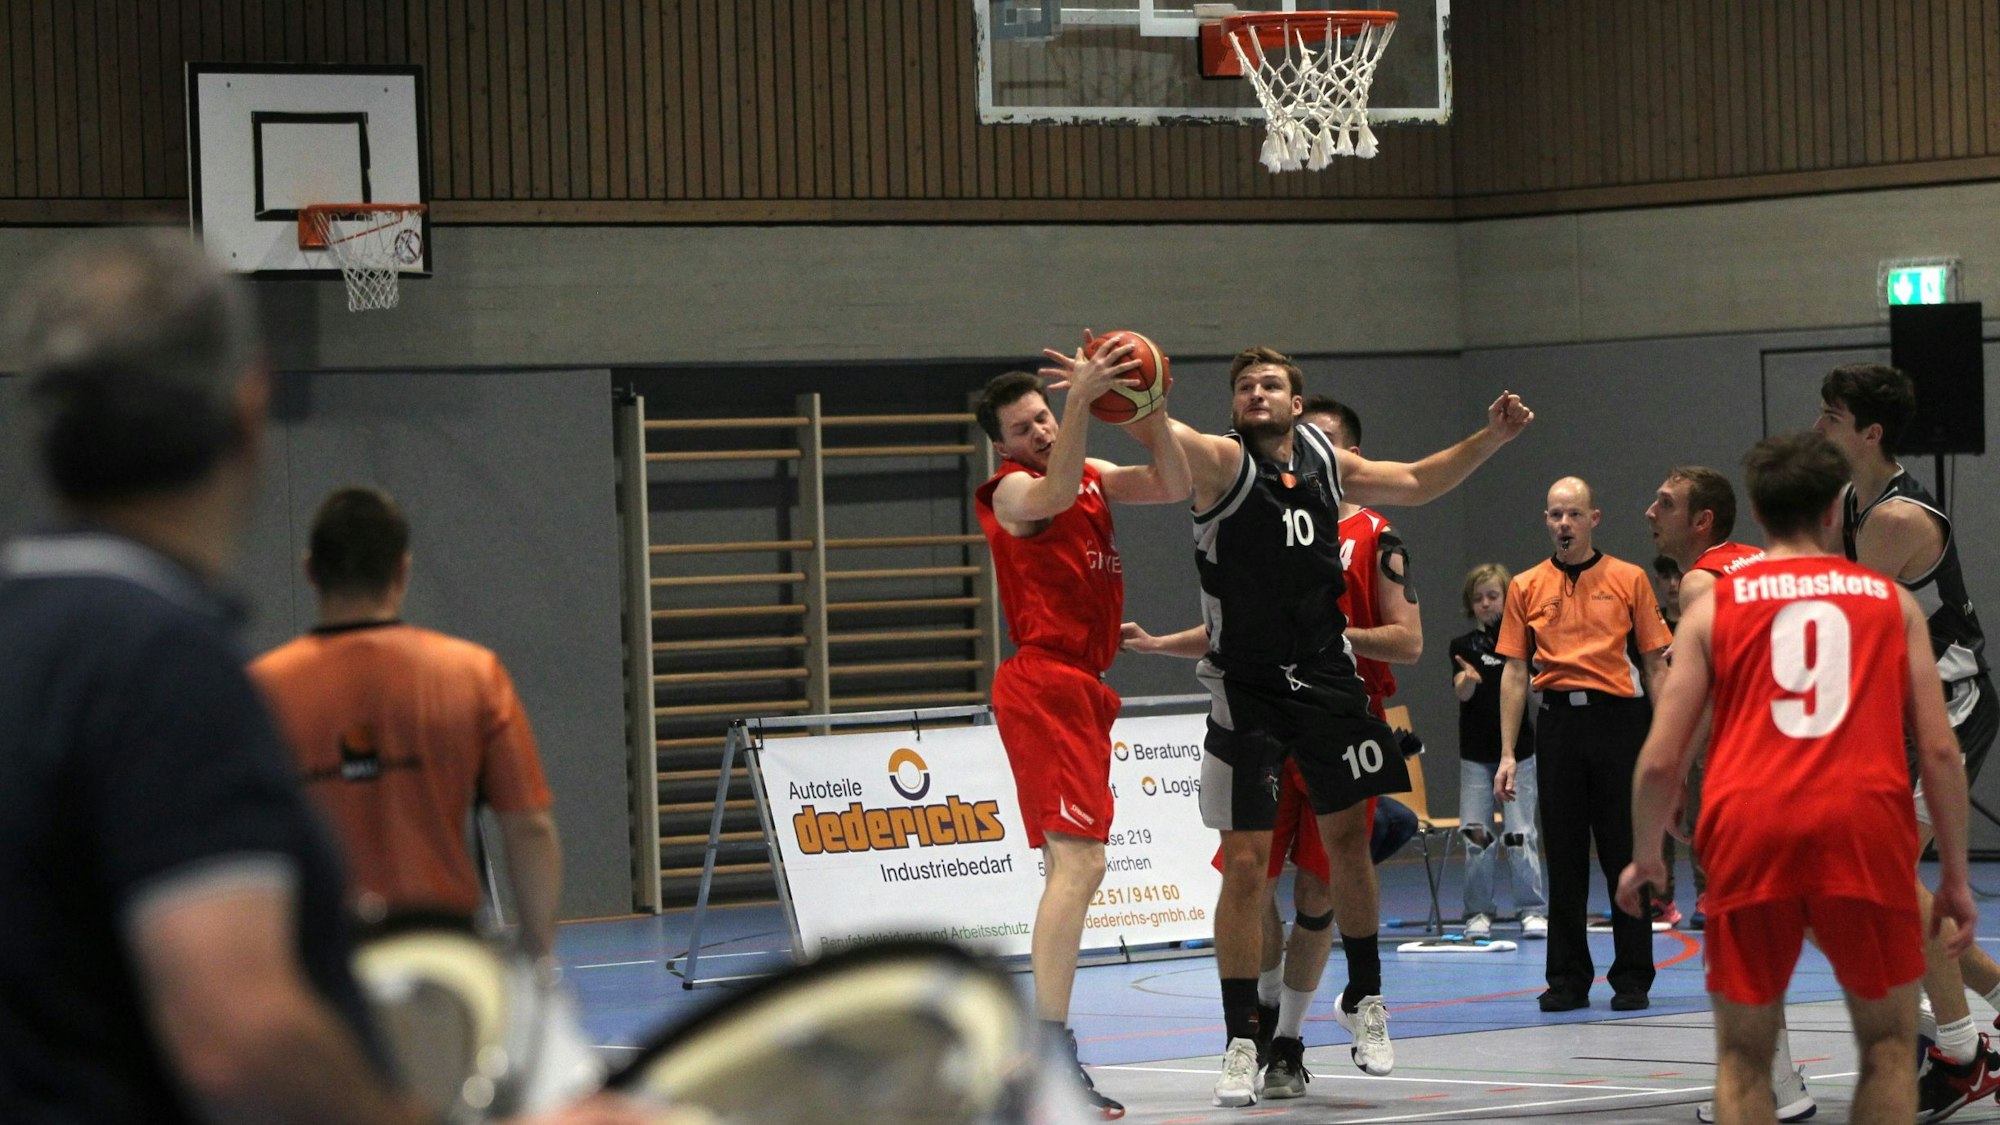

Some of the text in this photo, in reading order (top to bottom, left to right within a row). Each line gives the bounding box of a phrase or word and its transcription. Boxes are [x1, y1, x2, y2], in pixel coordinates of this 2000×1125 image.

[1282, 508, 1315, 547] 10
[1770, 600, 1852, 739] 9
[1133, 741, 1201, 762] Beratung
[1342, 739, 1384, 780] 10
[789, 778, 863, 800] Autoteile
[792, 795, 1005, 855] dederichs
[1128, 828, 1153, 845] 219
[880, 854, 1014, 883] Industriebedarf
[925, 927, 948, 942] und
[951, 921, 1031, 940] Arbeitsschutz
